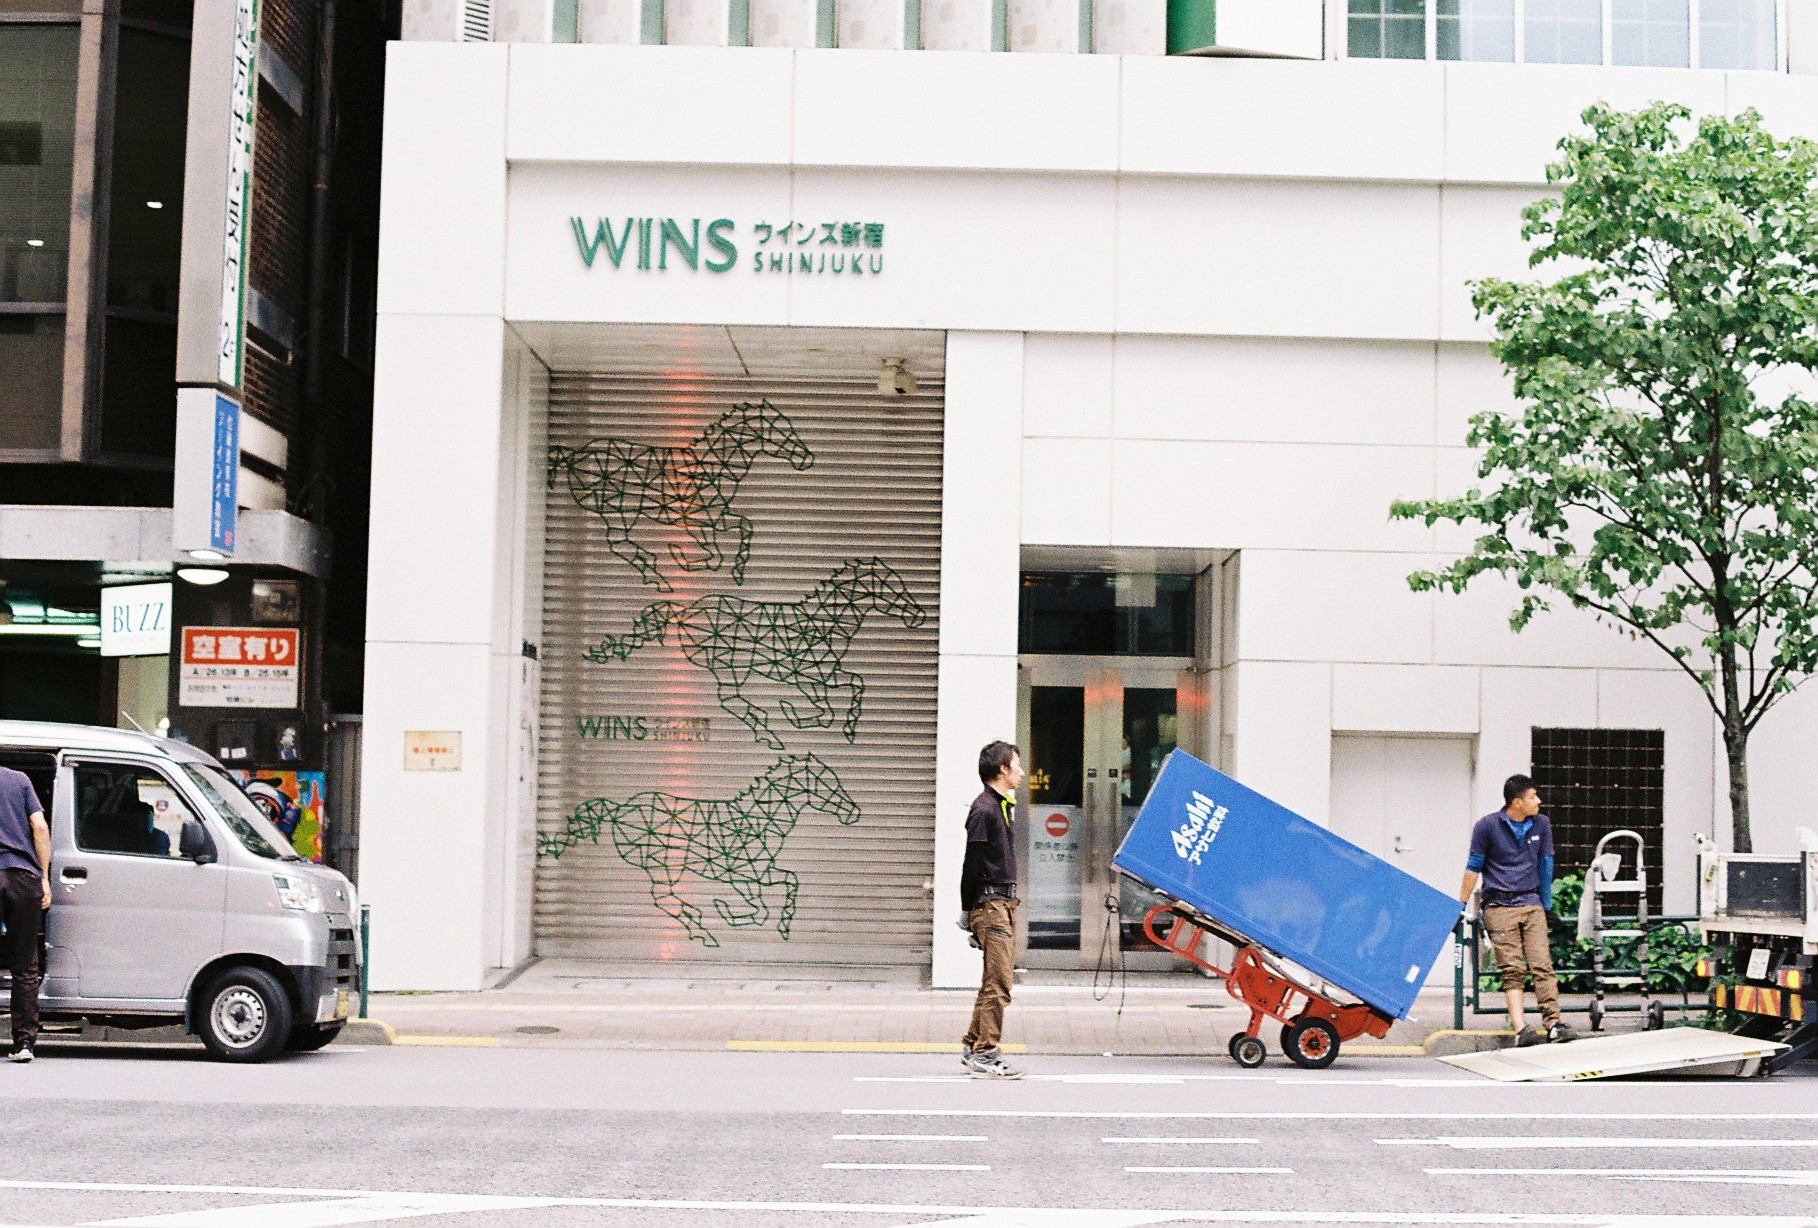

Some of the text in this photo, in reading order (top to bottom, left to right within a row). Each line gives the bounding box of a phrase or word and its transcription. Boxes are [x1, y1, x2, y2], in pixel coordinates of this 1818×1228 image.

[569, 216, 738, 273] WINS
[753, 220, 885, 248] ウインズ新宿
[753, 251, 884, 275] SHINJUKU
[113, 603, 165, 633] BUZZ
[192, 634, 289, 661] 空室有り
[575, 714, 648, 741] WINS
[1171, 790, 1215, 859] Asahi
[1188, 804, 1230, 866] アサヒ飲料
